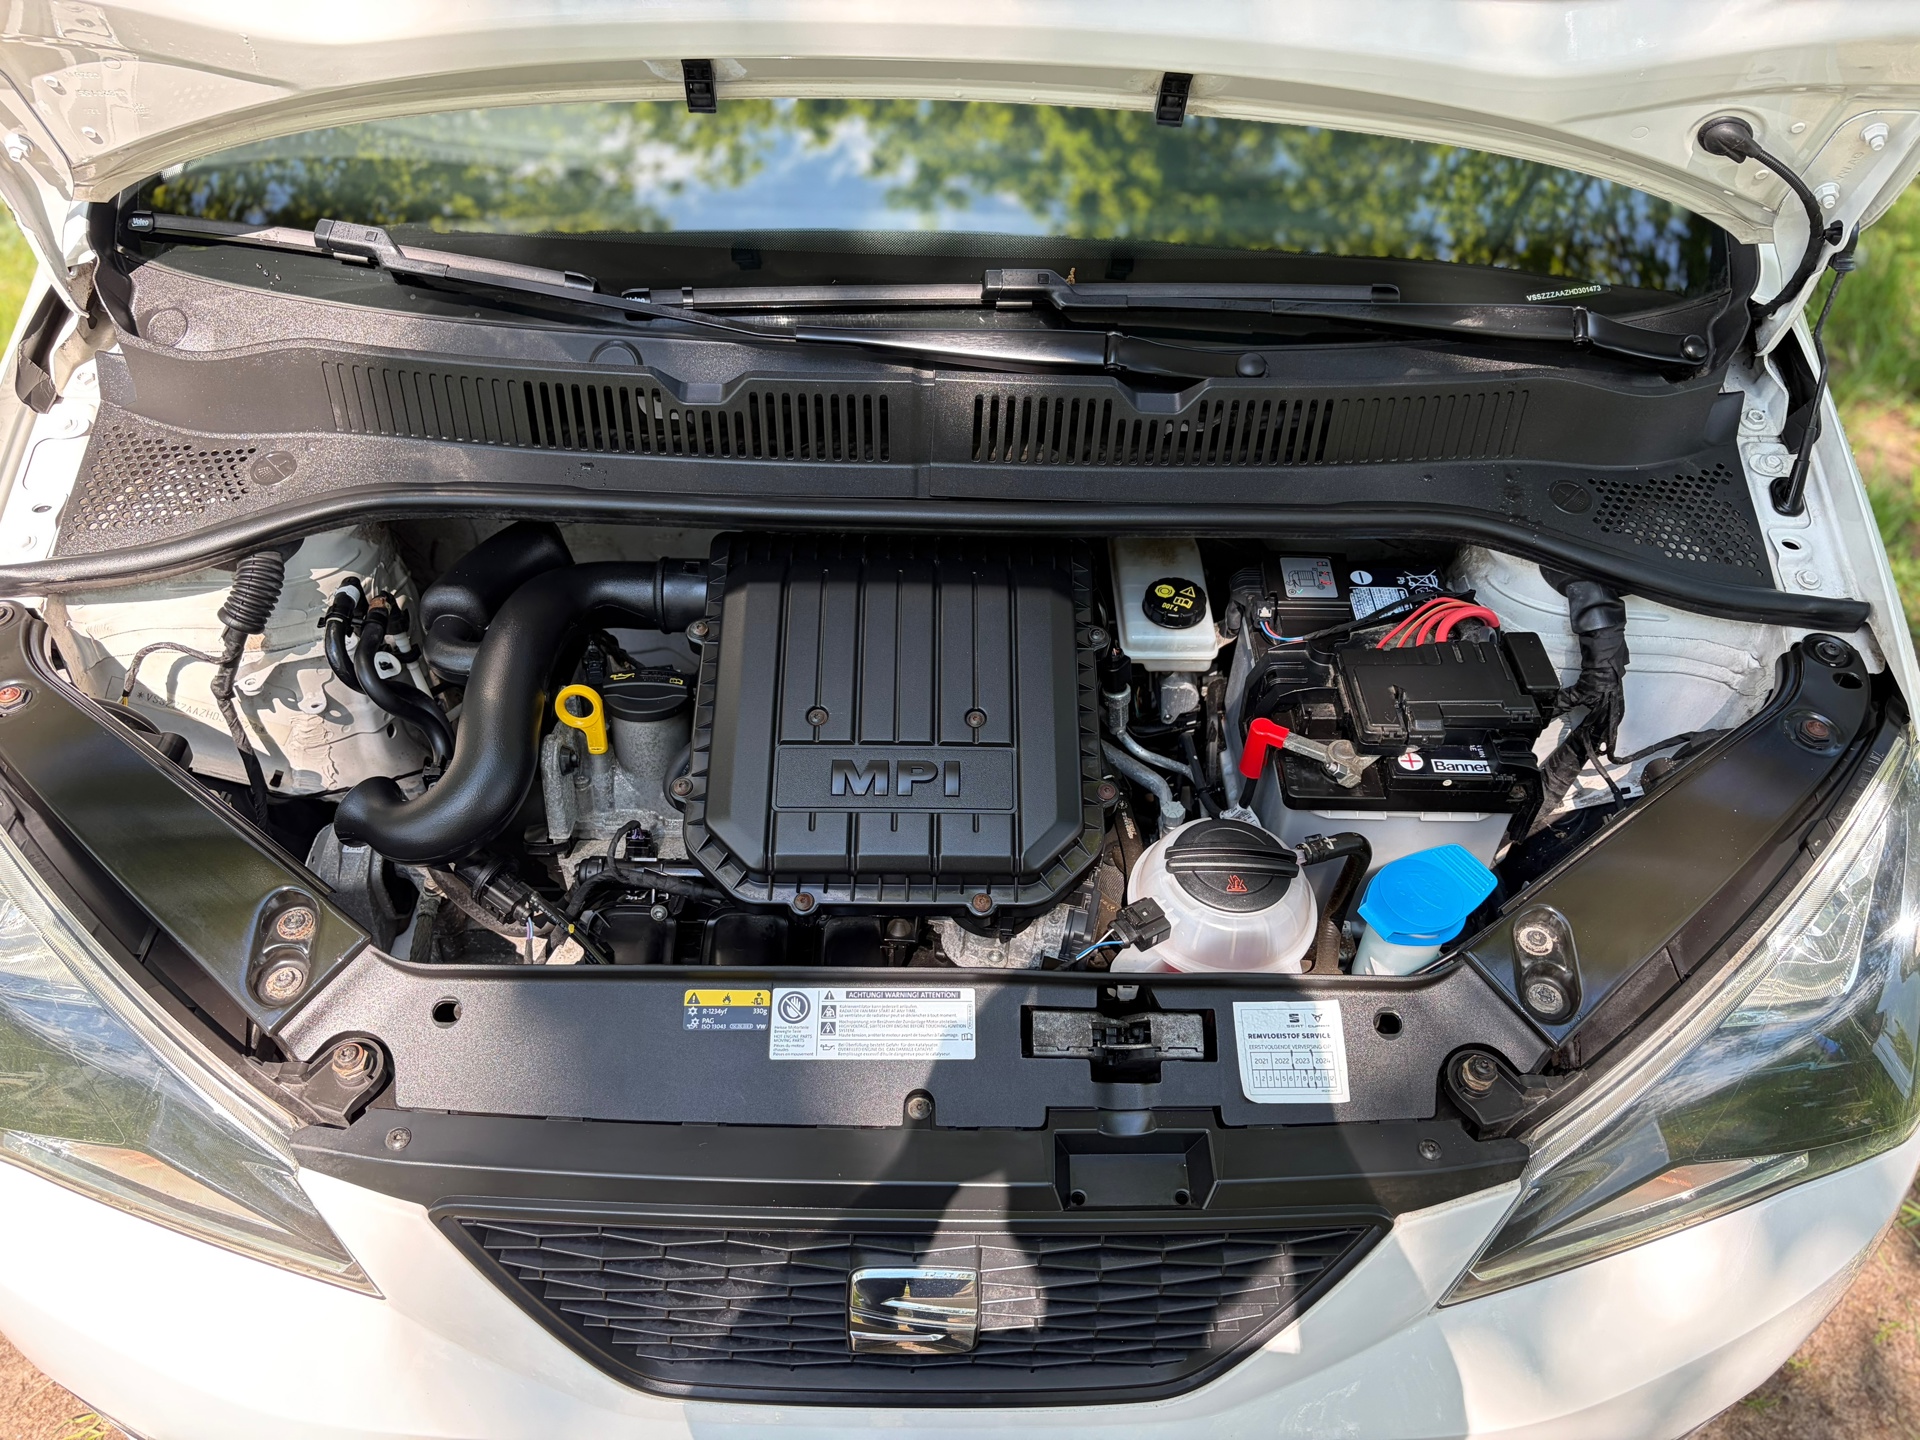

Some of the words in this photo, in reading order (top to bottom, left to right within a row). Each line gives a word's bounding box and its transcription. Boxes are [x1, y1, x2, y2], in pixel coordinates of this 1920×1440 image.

[131, 217, 149, 227] Valeo
[1526, 284, 1602, 302] VSSZZZAAZHD301473
[1161, 602, 1175, 610] DOT
[1434, 760, 1491, 773] Banner
[830, 759, 962, 798] MPI
[702, 1008, 728, 1016] R-1234yf
[753, 1008, 768, 1016] 330g
